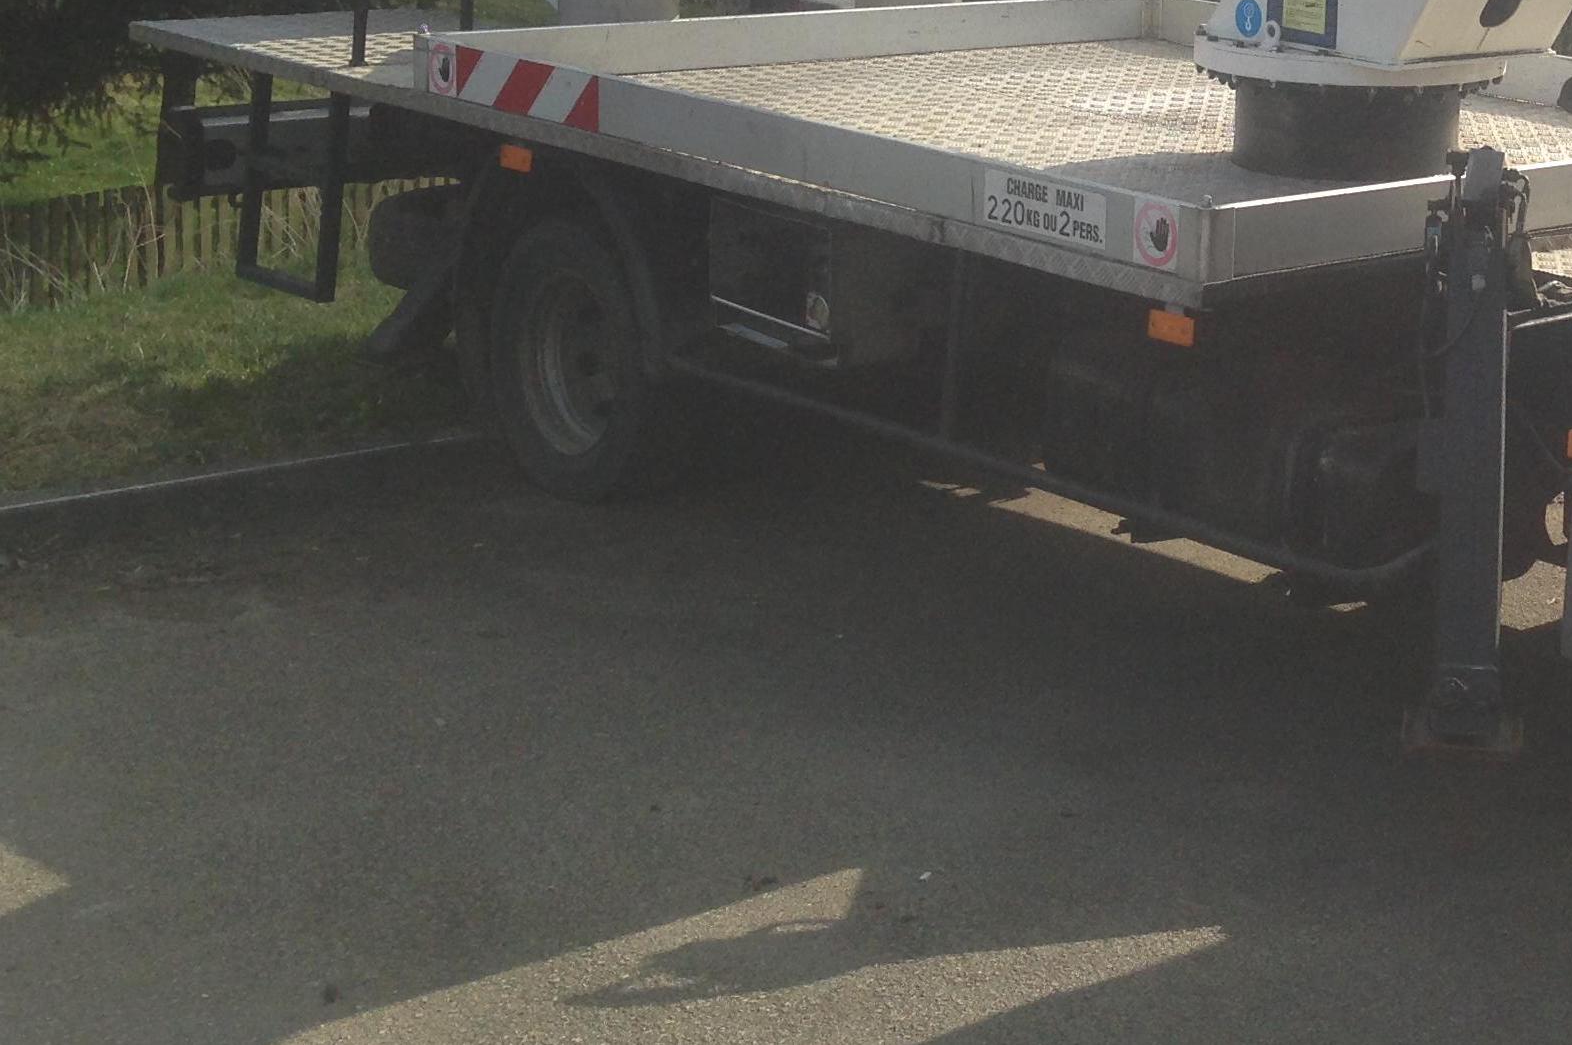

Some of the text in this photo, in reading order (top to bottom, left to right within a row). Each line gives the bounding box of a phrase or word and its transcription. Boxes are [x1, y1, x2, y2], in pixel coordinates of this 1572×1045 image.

[1006, 177, 1084, 212] CHARGE MAXI
[987, 194, 1103, 244] 220 KG OU 2 PERS.
